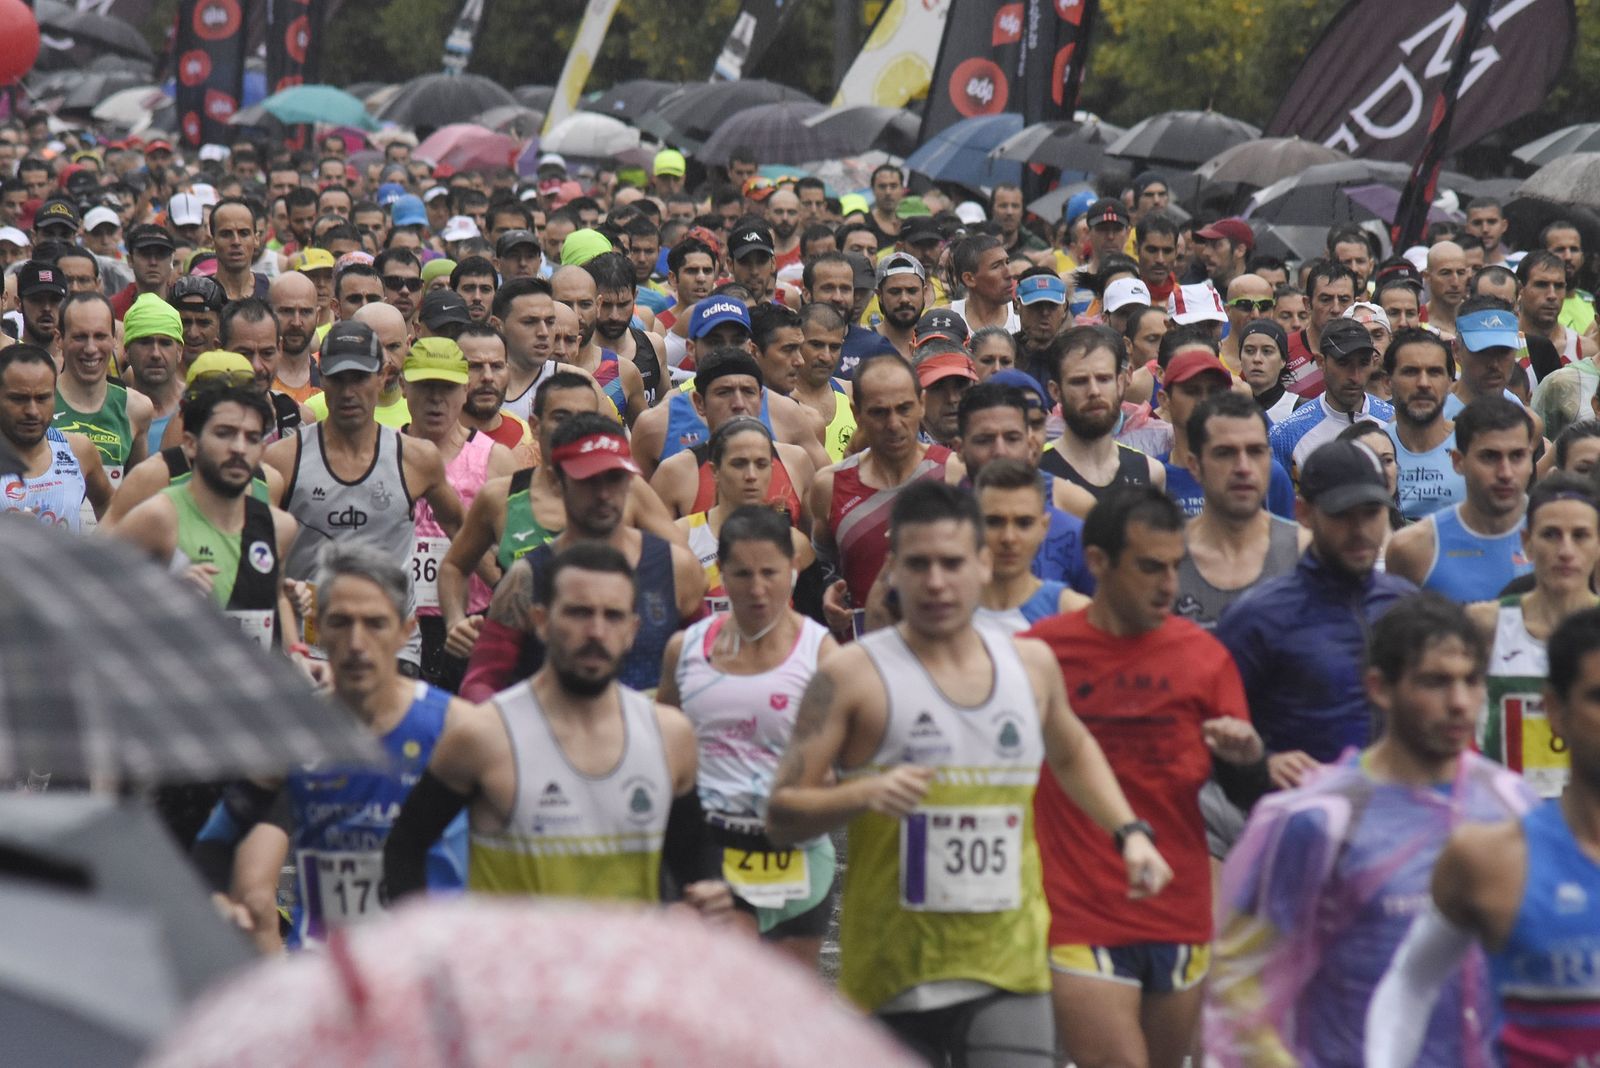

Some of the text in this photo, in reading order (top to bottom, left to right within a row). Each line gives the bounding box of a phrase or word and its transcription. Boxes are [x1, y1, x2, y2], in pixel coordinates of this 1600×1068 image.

[965, 77, 994, 104] edp
[702, 302, 743, 318] adidas
[327, 505, 368, 530] cdp
[945, 836, 1007, 874] 305
